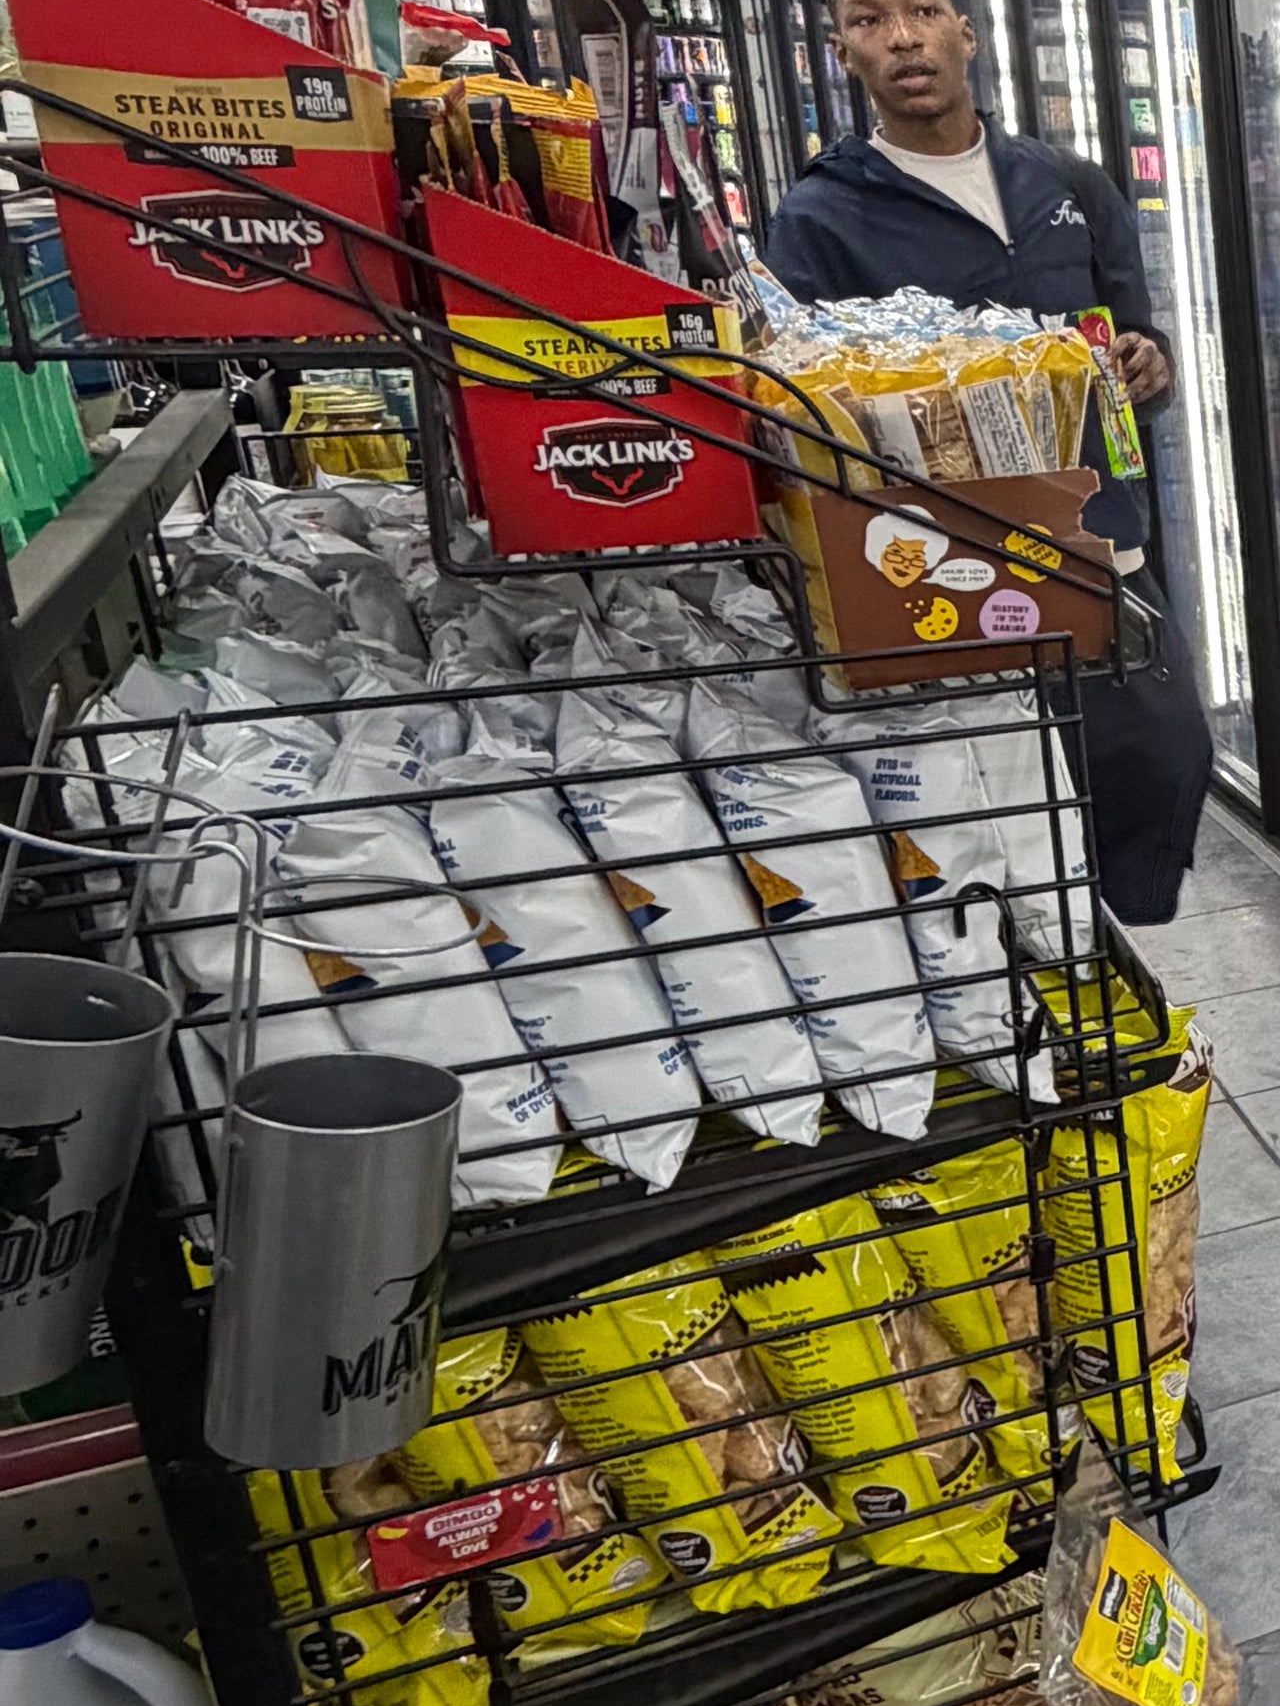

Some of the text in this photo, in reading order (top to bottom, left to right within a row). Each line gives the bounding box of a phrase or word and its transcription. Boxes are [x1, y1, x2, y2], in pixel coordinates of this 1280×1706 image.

[302, 77, 334, 97] 19g
[115, 94, 287, 118] STEAK BITES
[295, 95, 348, 113] PROTEIN
[150, 120, 266, 140] ORIGINAL
[250, 147, 280, 166] BEEF
[523, 335, 665, 357] STEAK ITES
[672, 329, 715, 344] PROTEIN
[633, 378, 658, 394] BEEF
[533, 437, 695, 473] JACK LINK'S
[870, 773, 922, 787] ARTIFICIAL
[431, 1503, 498, 1534] BIMBO
[436, 1522, 499, 1549] ALWAYS
[451, 1538, 490, 1560] LOVE
